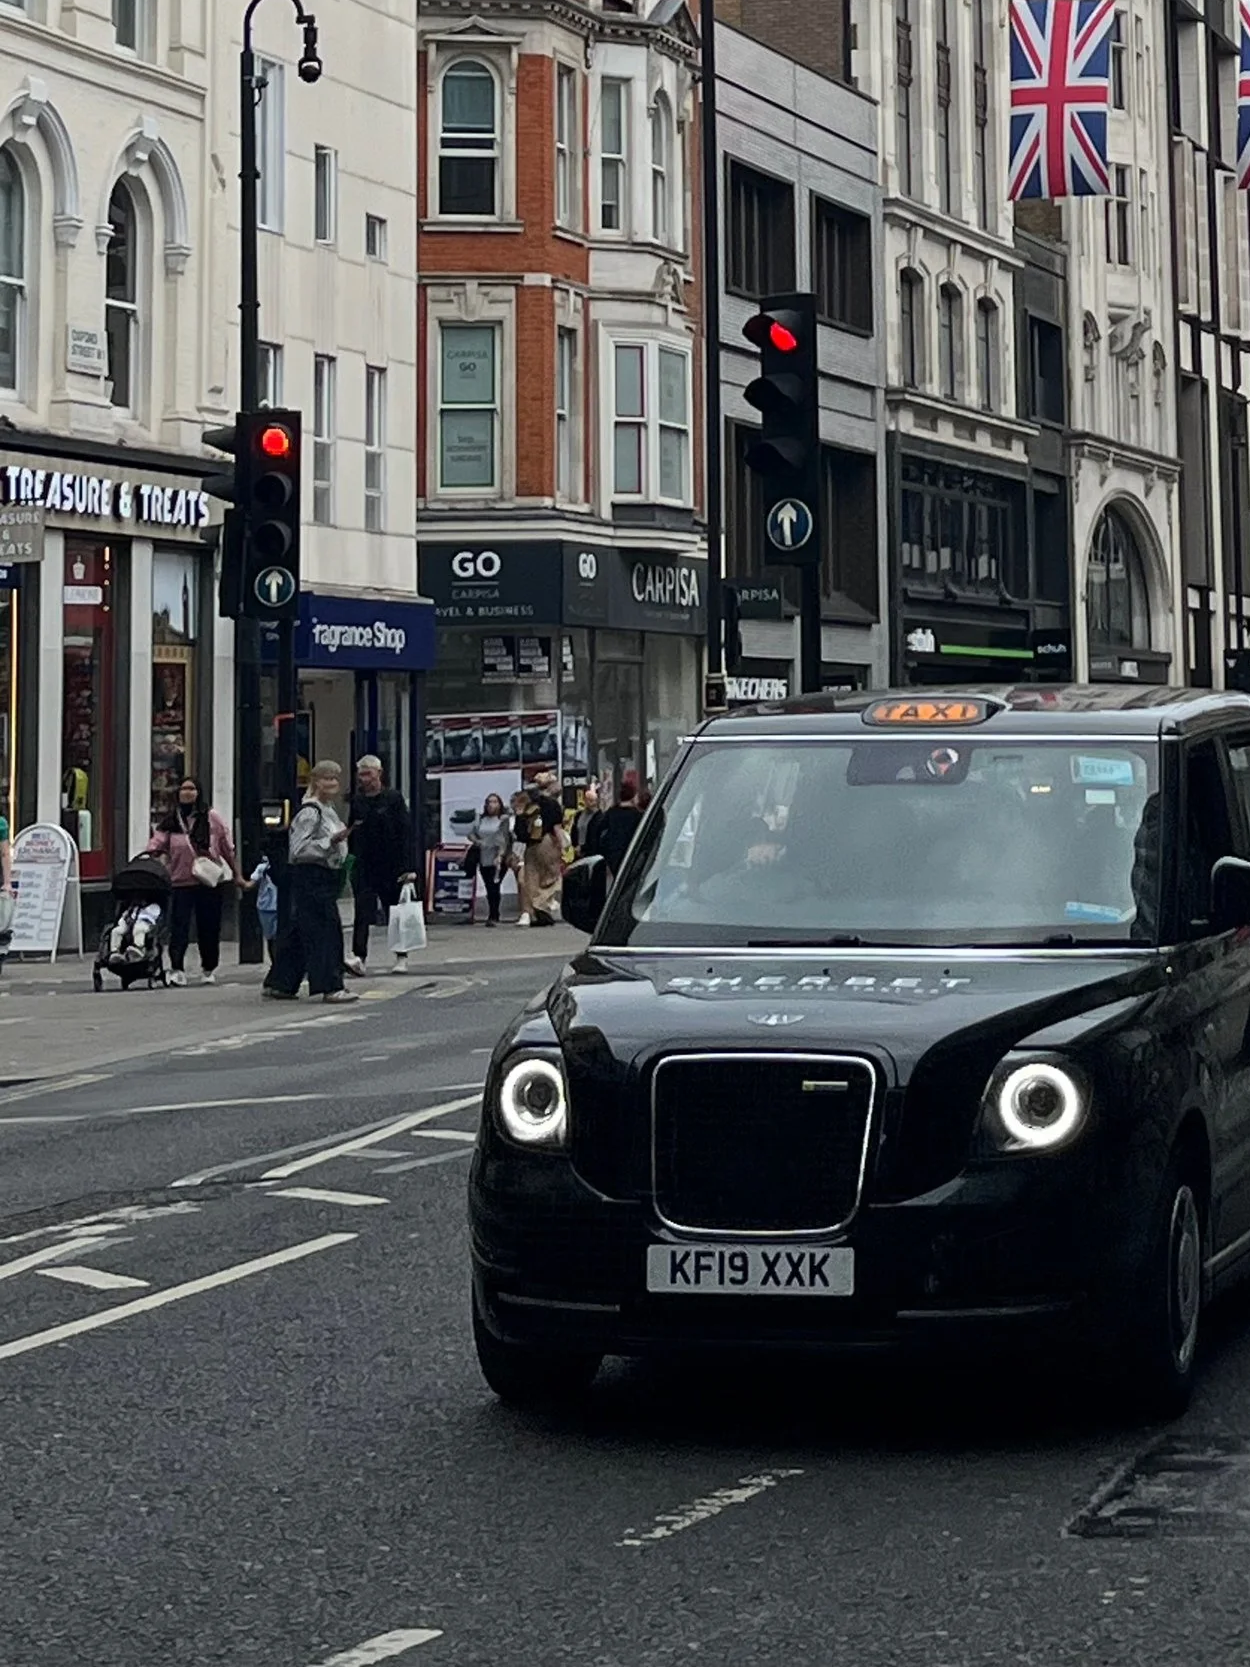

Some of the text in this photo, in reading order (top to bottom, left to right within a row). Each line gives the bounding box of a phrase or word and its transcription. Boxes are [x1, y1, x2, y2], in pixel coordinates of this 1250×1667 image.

[6, 465, 210, 528] TREASURE & TREATS
[451, 550, 501, 578] GO
[578, 552, 597, 579] GO
[632, 562, 700, 607] CARPISA
[373, 620, 406, 655] Shop
[725, 676, 788, 700] SKECHERS
[885, 701, 969, 720] TAXI
[669, 1249, 832, 1289] KF19 XXK
